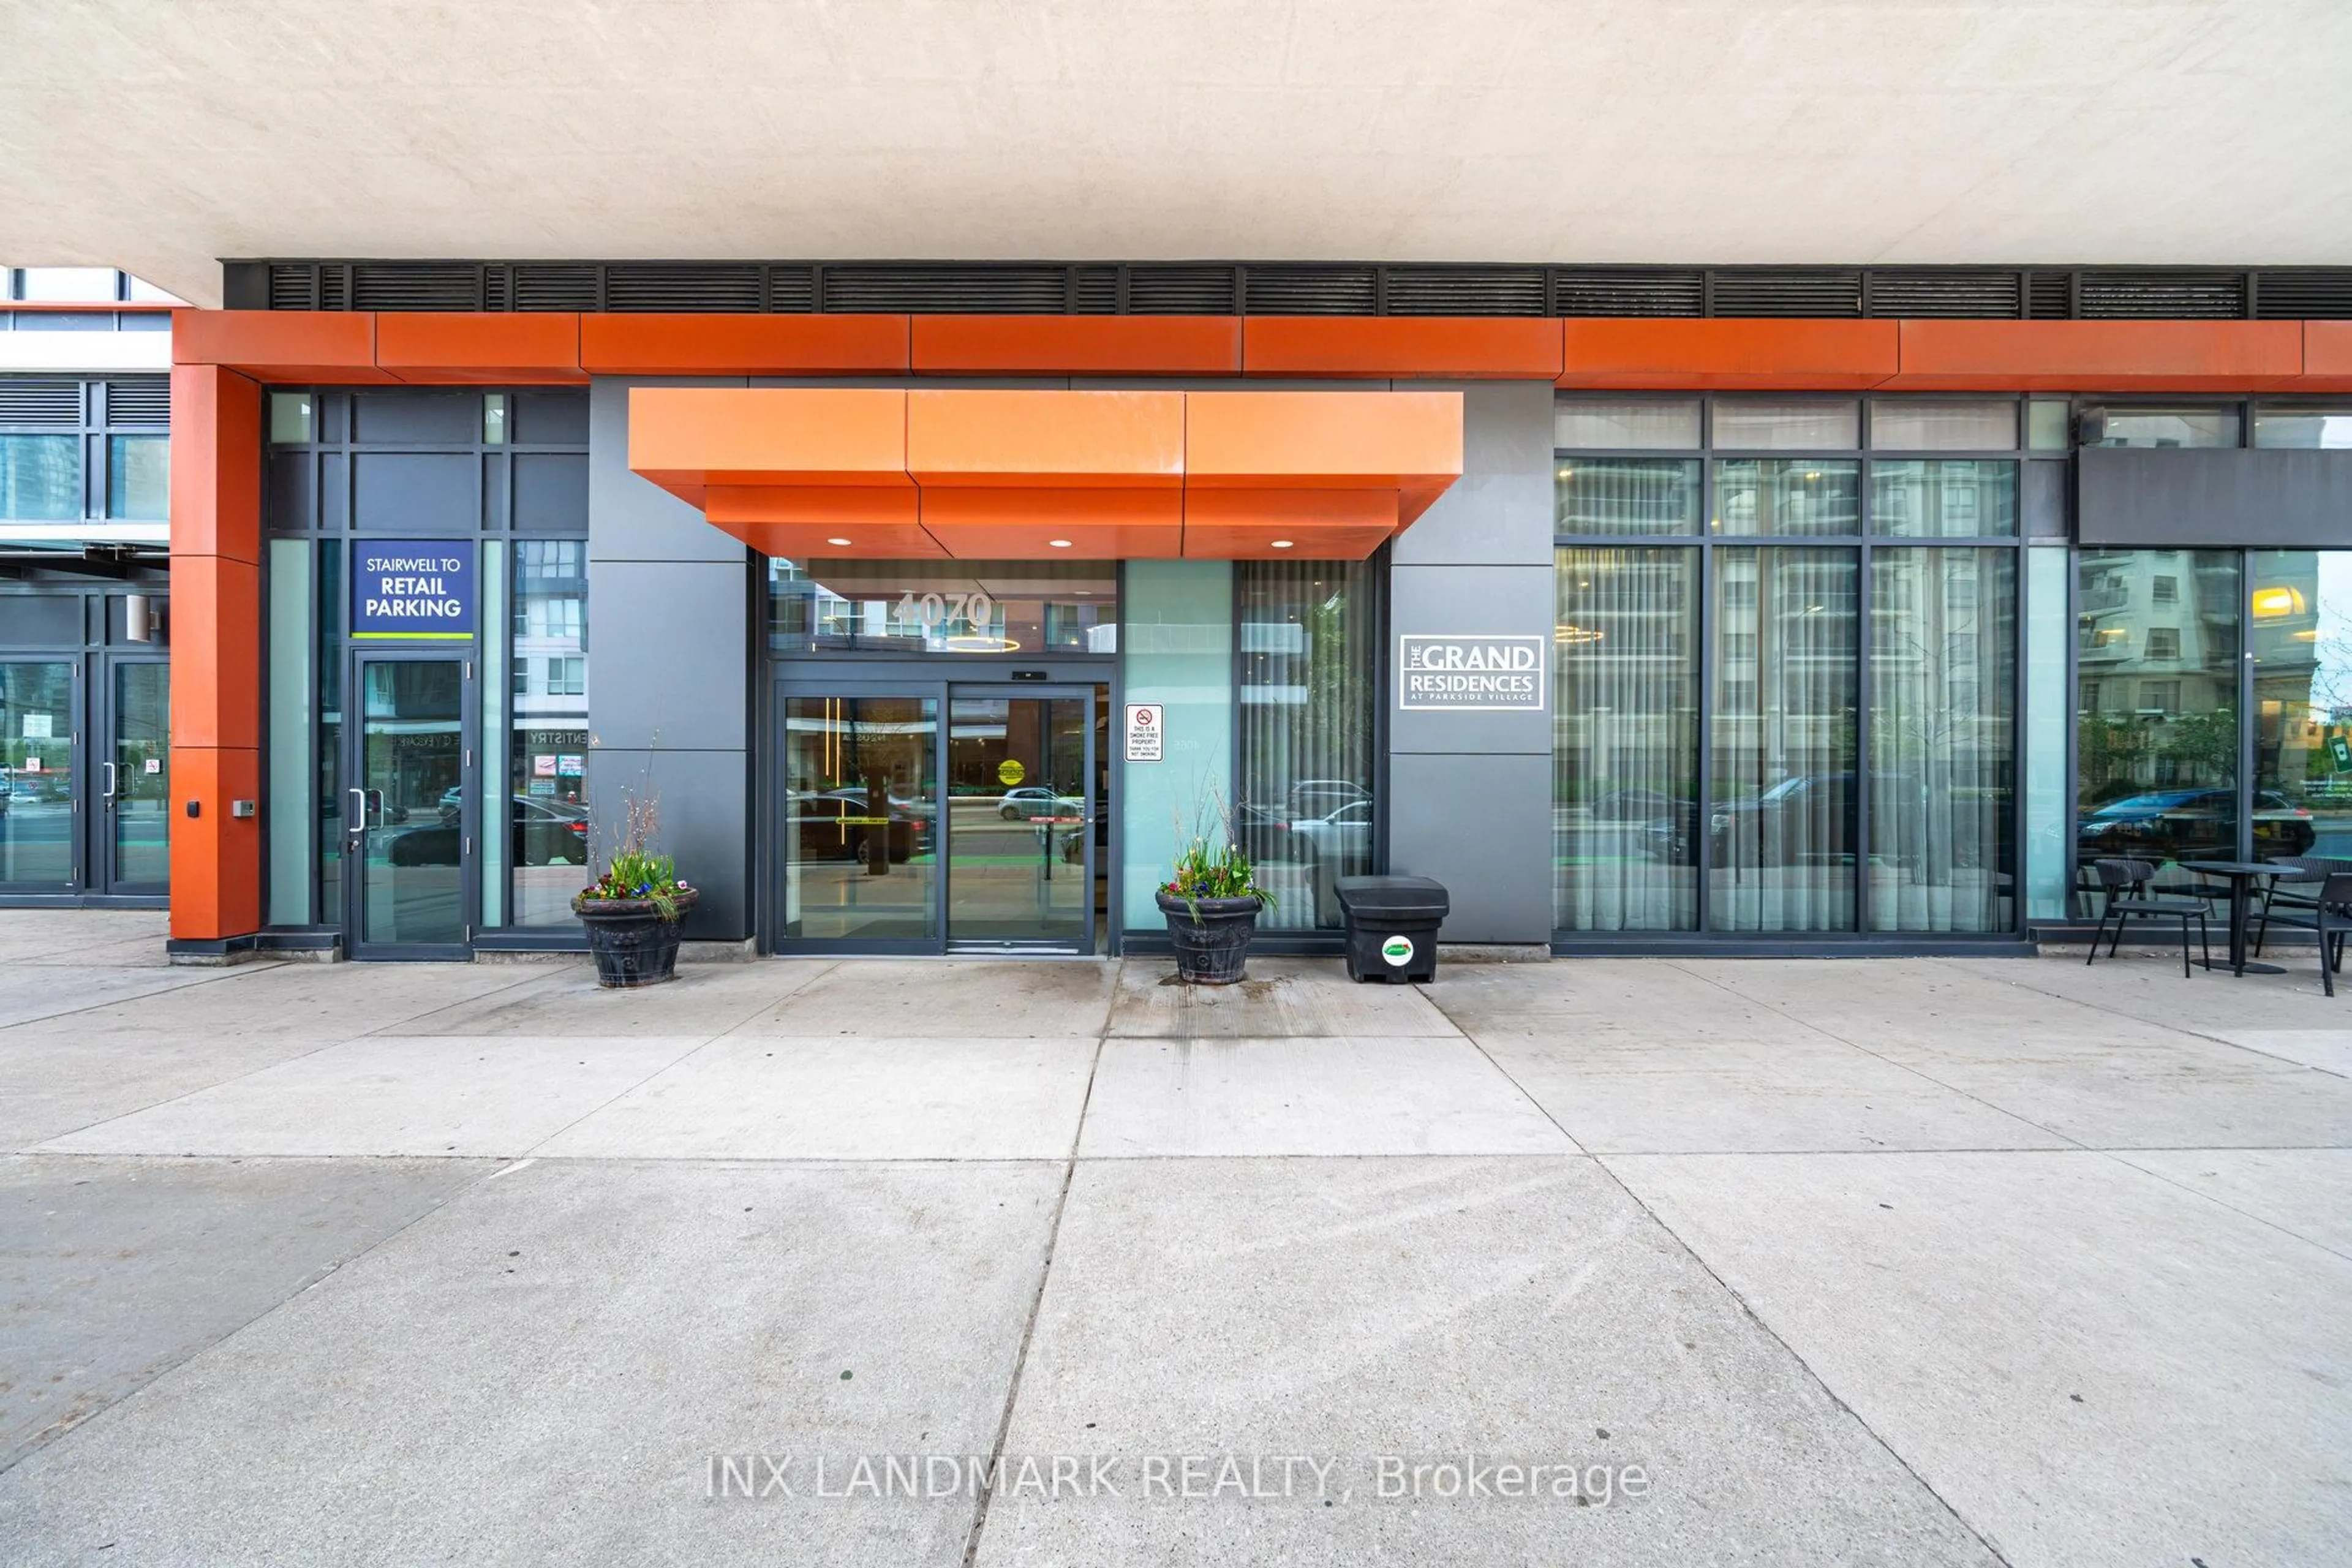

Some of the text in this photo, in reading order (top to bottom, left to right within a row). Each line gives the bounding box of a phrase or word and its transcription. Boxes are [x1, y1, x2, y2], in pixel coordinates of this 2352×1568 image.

[366, 559, 461, 571] STAIRWELL TO
[382, 577, 447, 595] RETAIL
[366, 599, 461, 617] PARKING
[892, 592, 992, 626] 4070
[1411, 645, 1421, 669] THE
[1422, 646, 1534, 669] GRAND
[1411, 675, 1533, 692] RESIDENCES
